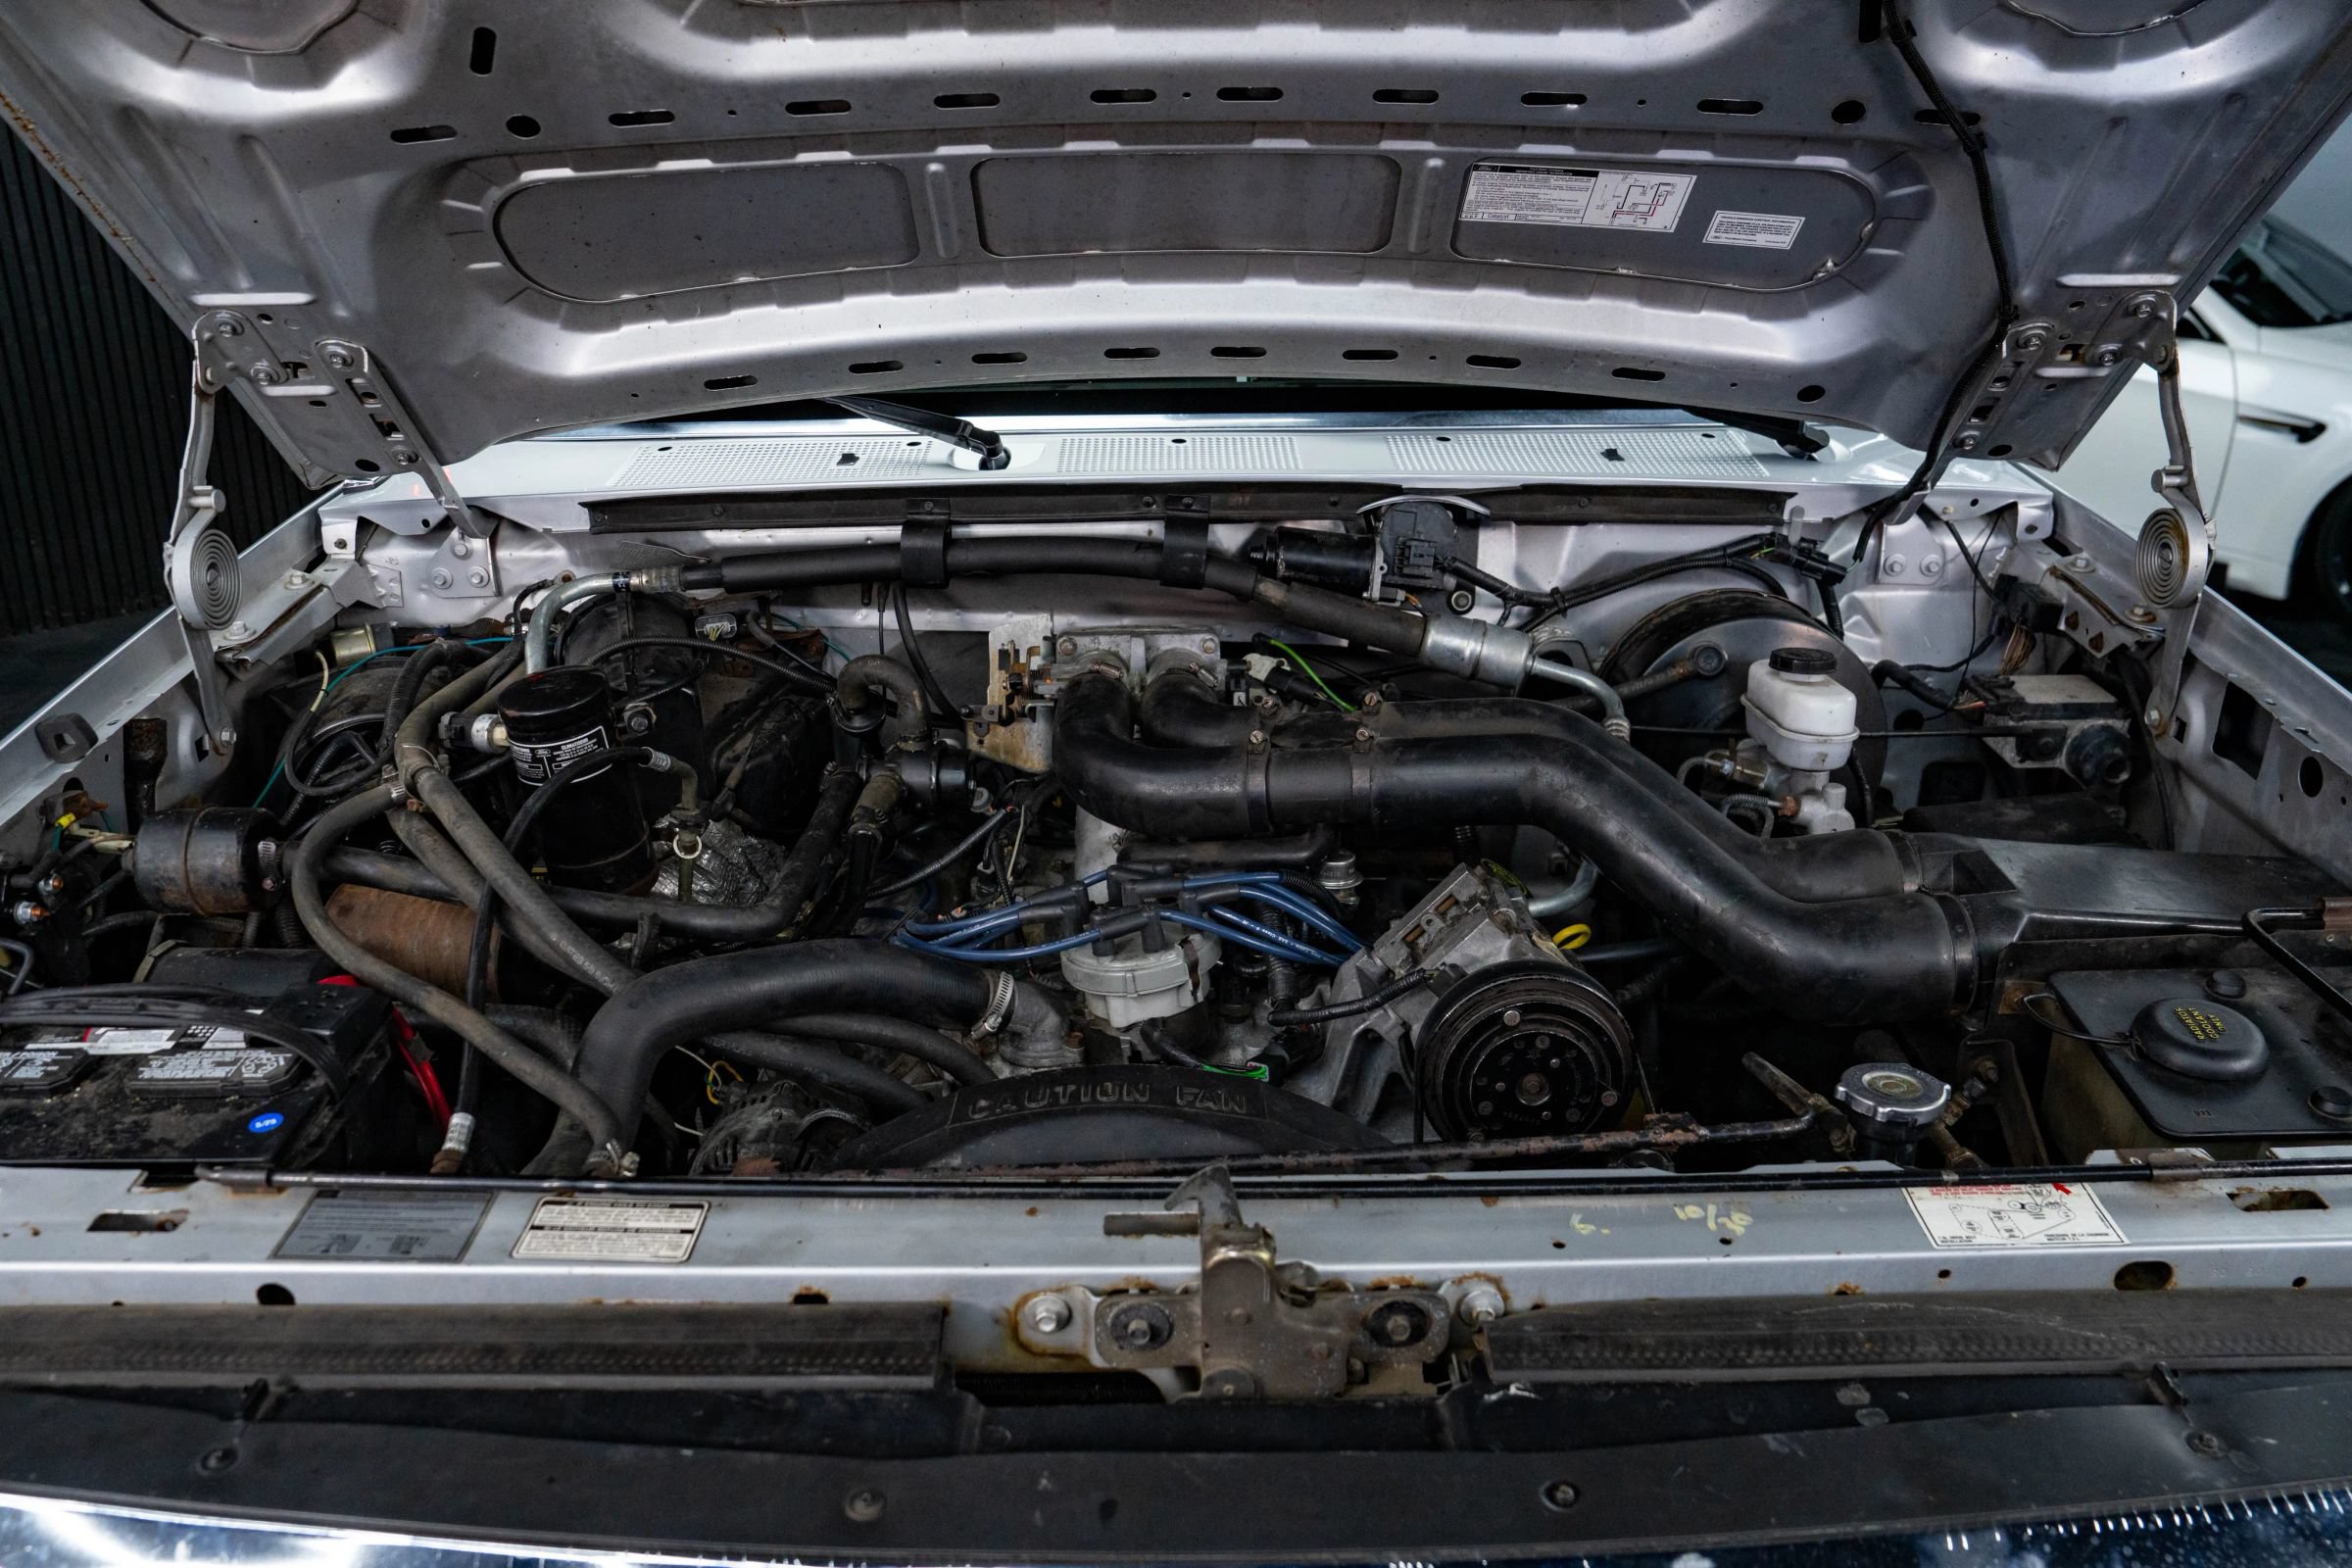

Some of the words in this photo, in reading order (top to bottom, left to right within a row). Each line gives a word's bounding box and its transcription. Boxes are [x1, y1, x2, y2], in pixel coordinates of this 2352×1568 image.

[2175, 1006, 2205, 1040] RADIATOR
[2187, 1006, 2219, 1039] COOLANT
[2208, 1013, 2228, 1033] ONLY
[967, 1081, 1151, 1120] CAUTION
[1175, 1085, 1248, 1115] FAN
